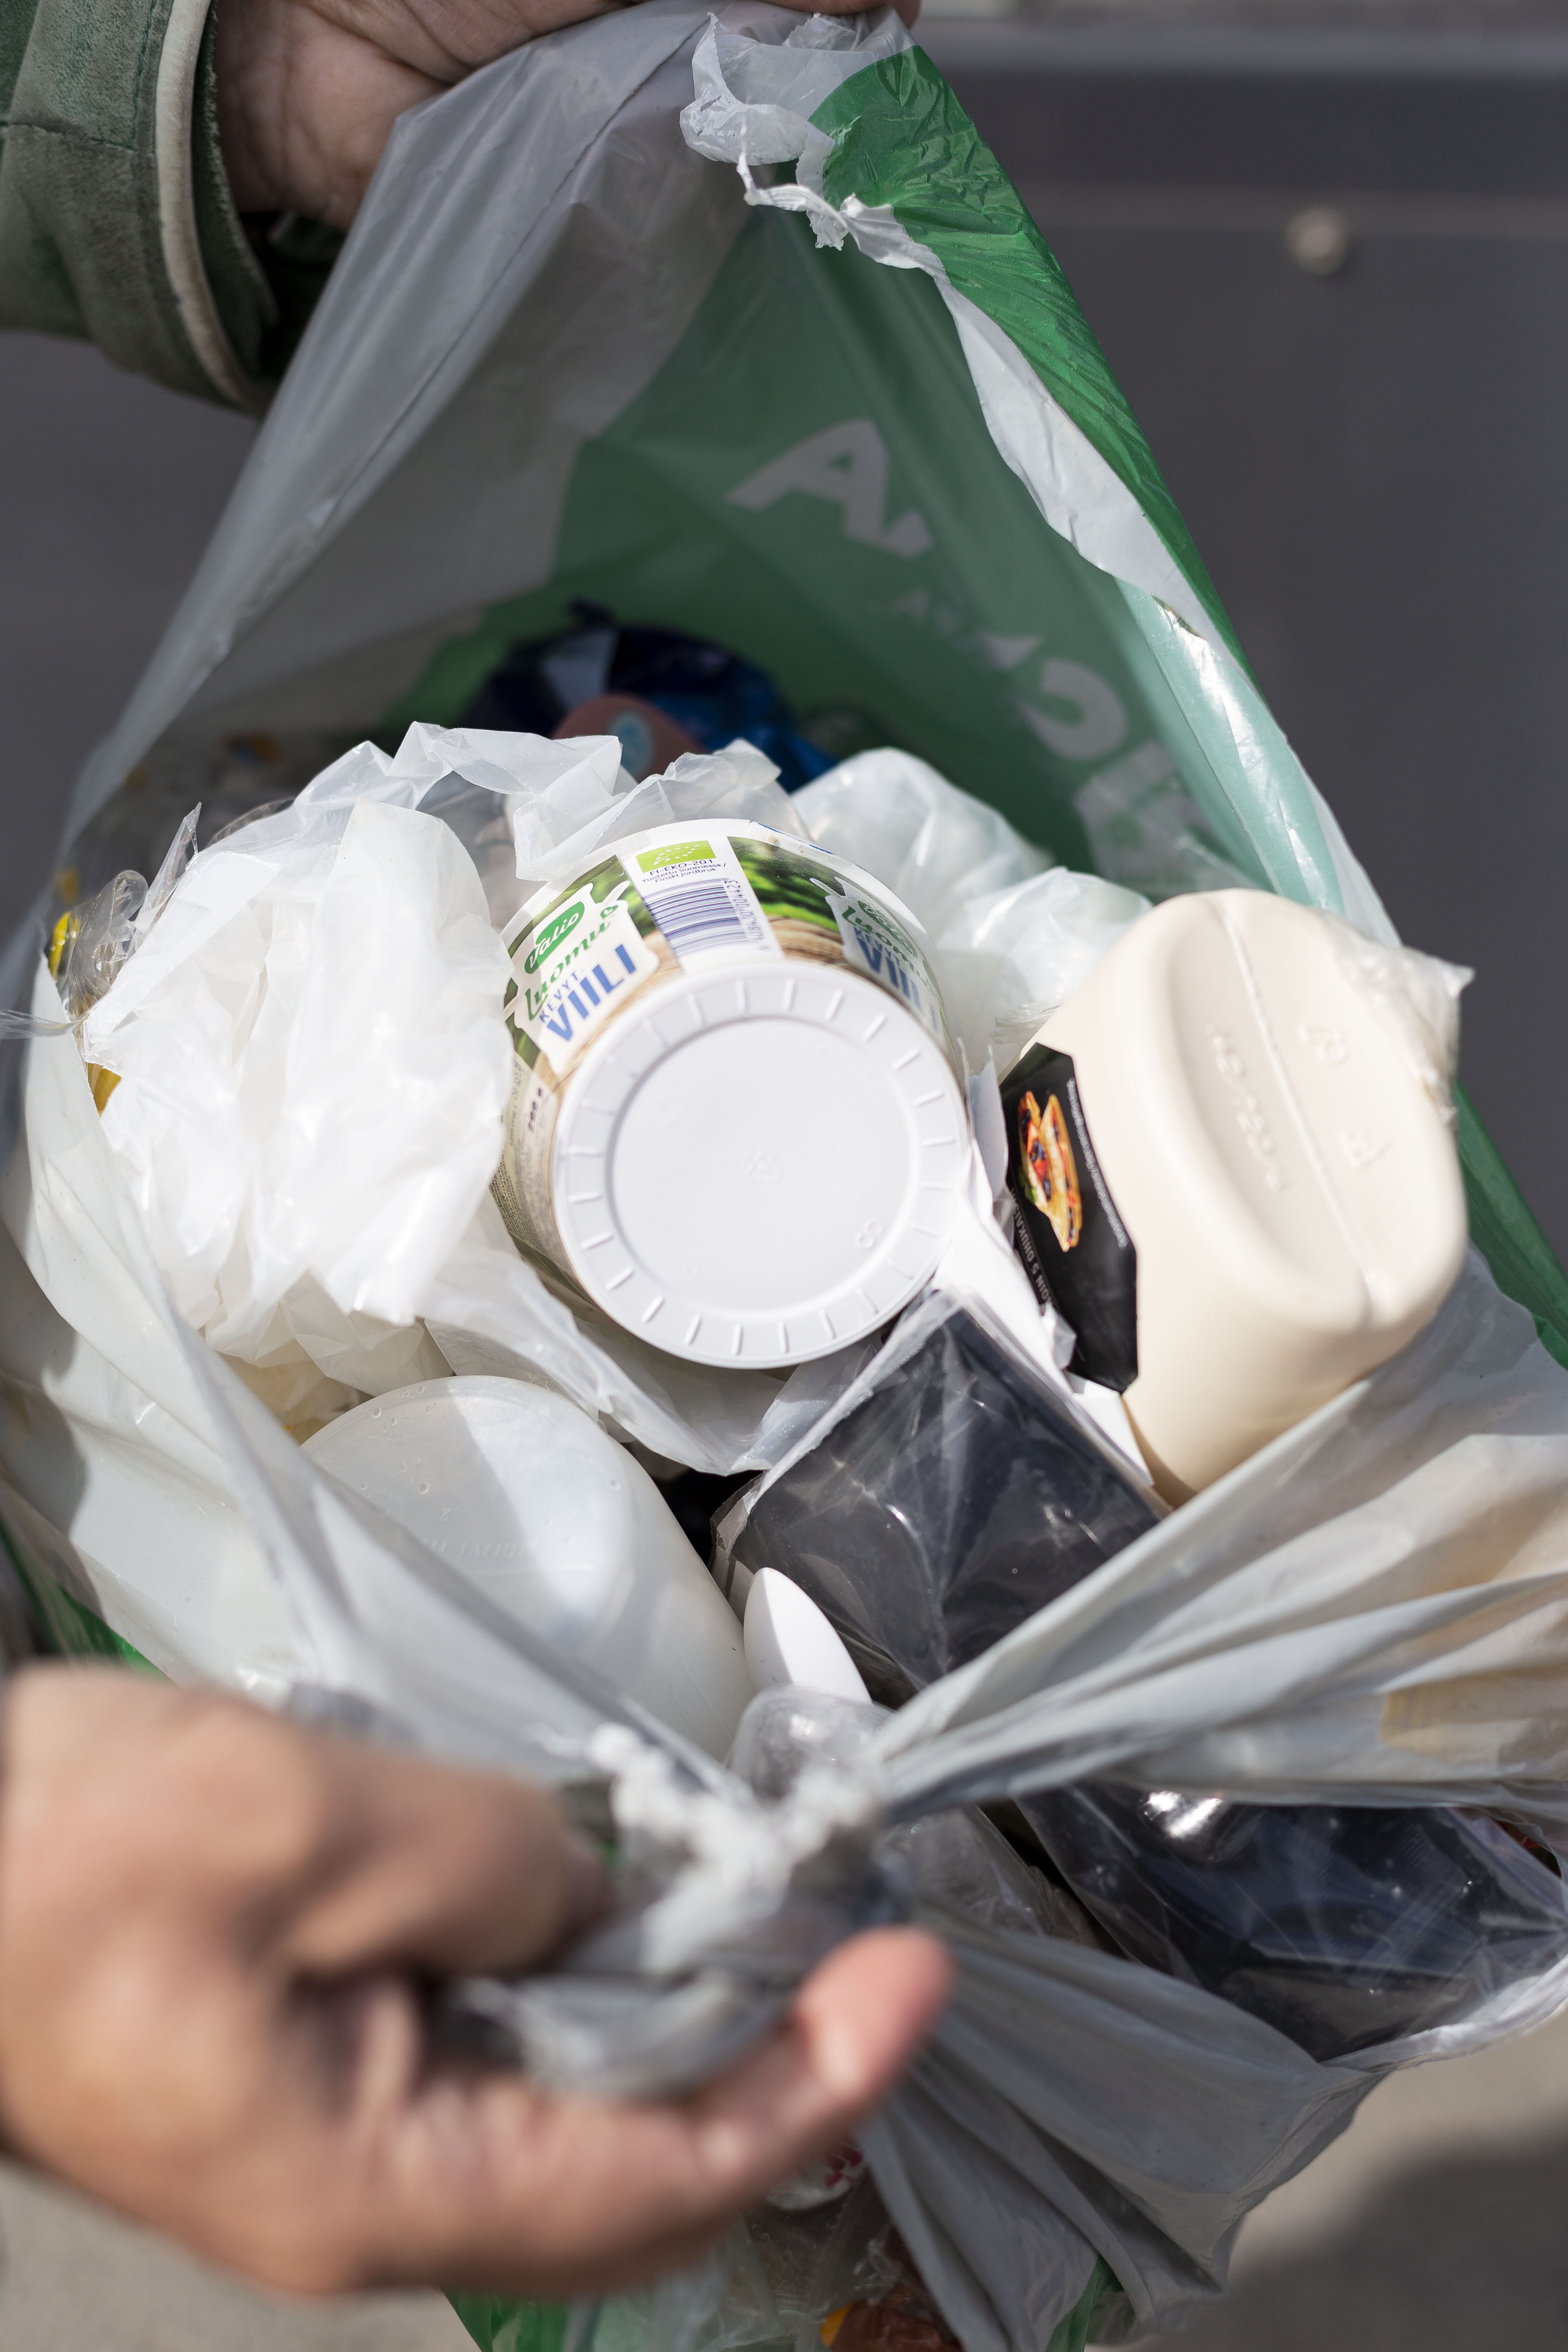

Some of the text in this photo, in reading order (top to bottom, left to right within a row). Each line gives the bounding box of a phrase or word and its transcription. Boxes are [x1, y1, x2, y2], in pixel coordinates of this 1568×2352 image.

[642, 870, 677, 883] Tuotettu
[679, 864, 721, 872] Suomessa
[649, 859, 713, 876] FI-EKO-201
[655, 867, 717, 883] Finskt jordbruk
[530, 912, 580, 968] Valio
[525, 922, 610, 1021] Luomu
[546, 944, 636, 1041] VIILI
